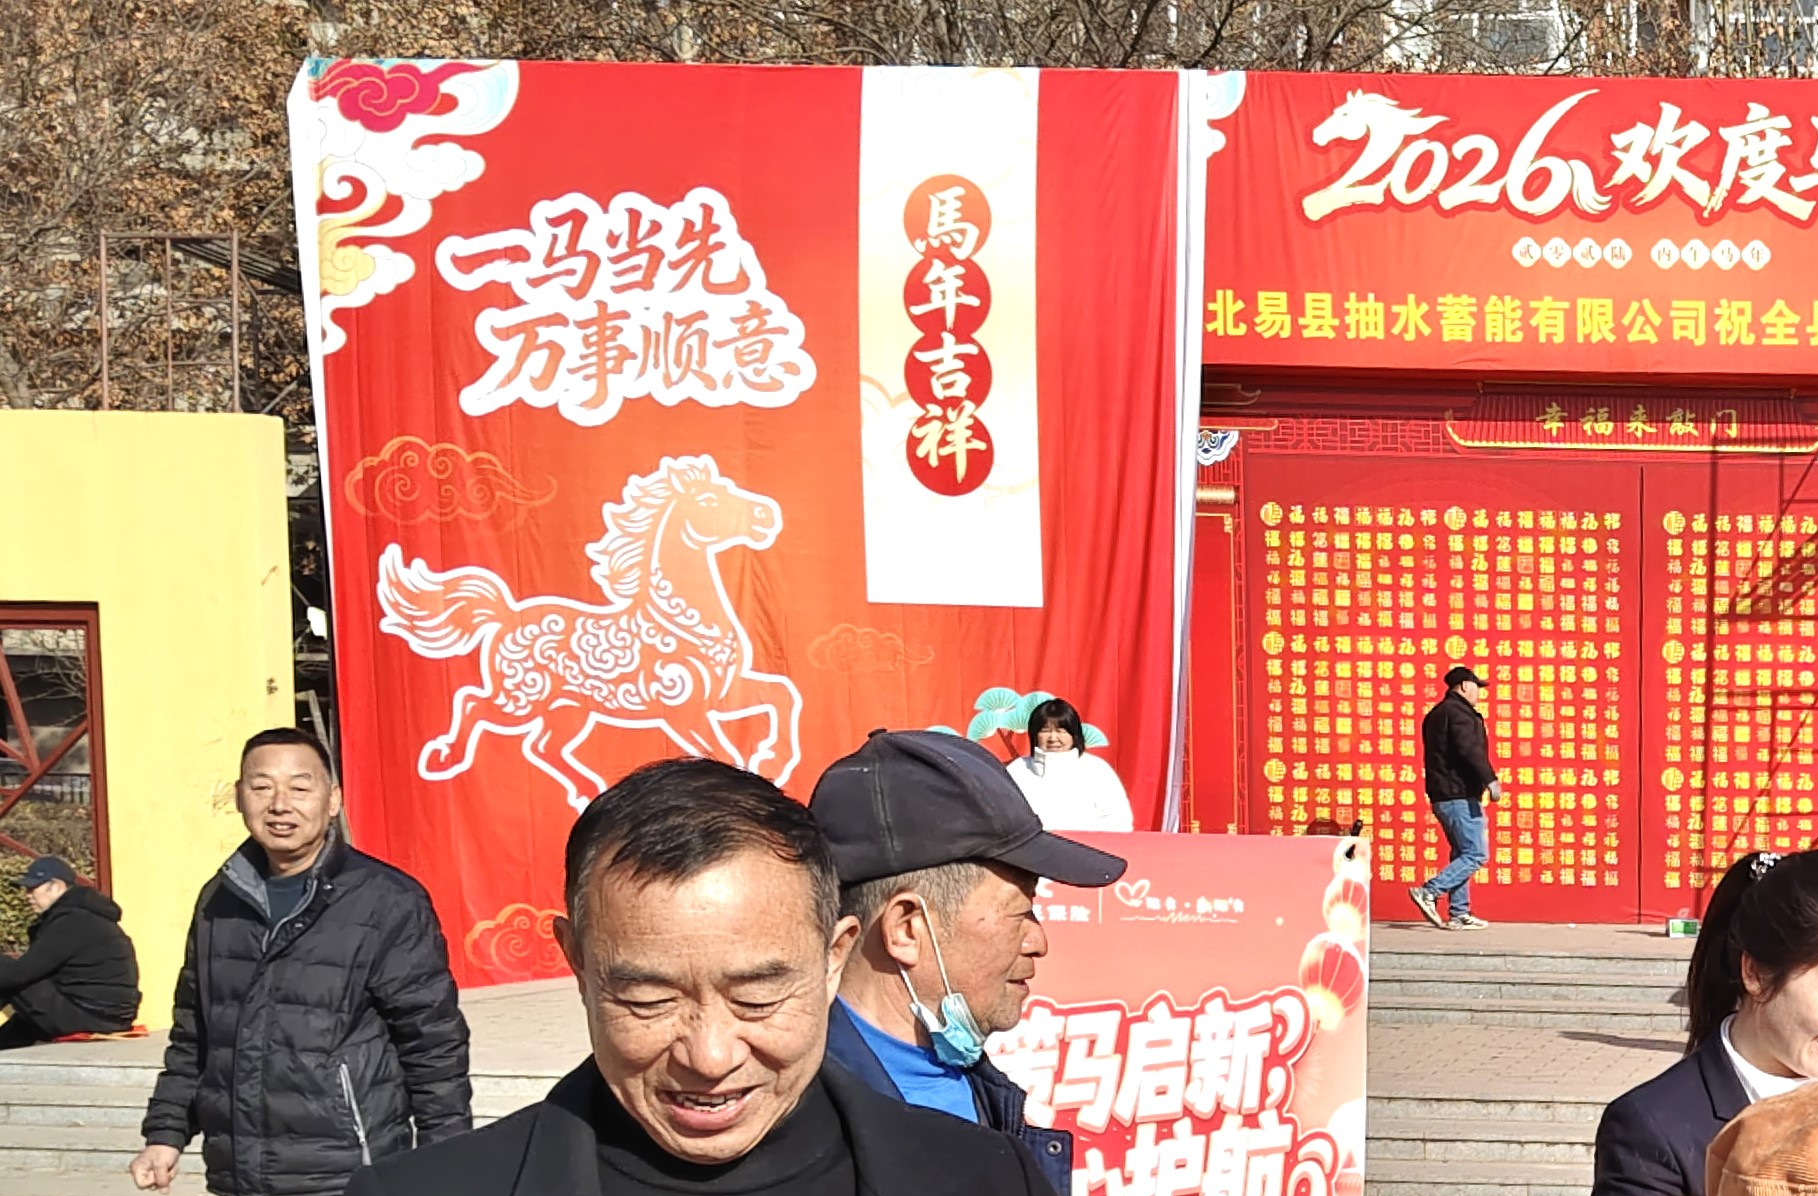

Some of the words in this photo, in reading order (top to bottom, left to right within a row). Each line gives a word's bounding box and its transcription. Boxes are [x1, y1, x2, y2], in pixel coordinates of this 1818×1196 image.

[450, 202, 751, 300] 一马当先
[477, 300, 801, 410] 万事顺意
[911, 188, 987, 485] 馬年吉祥
[1536, 402, 1738, 438] 幸福来敲门
